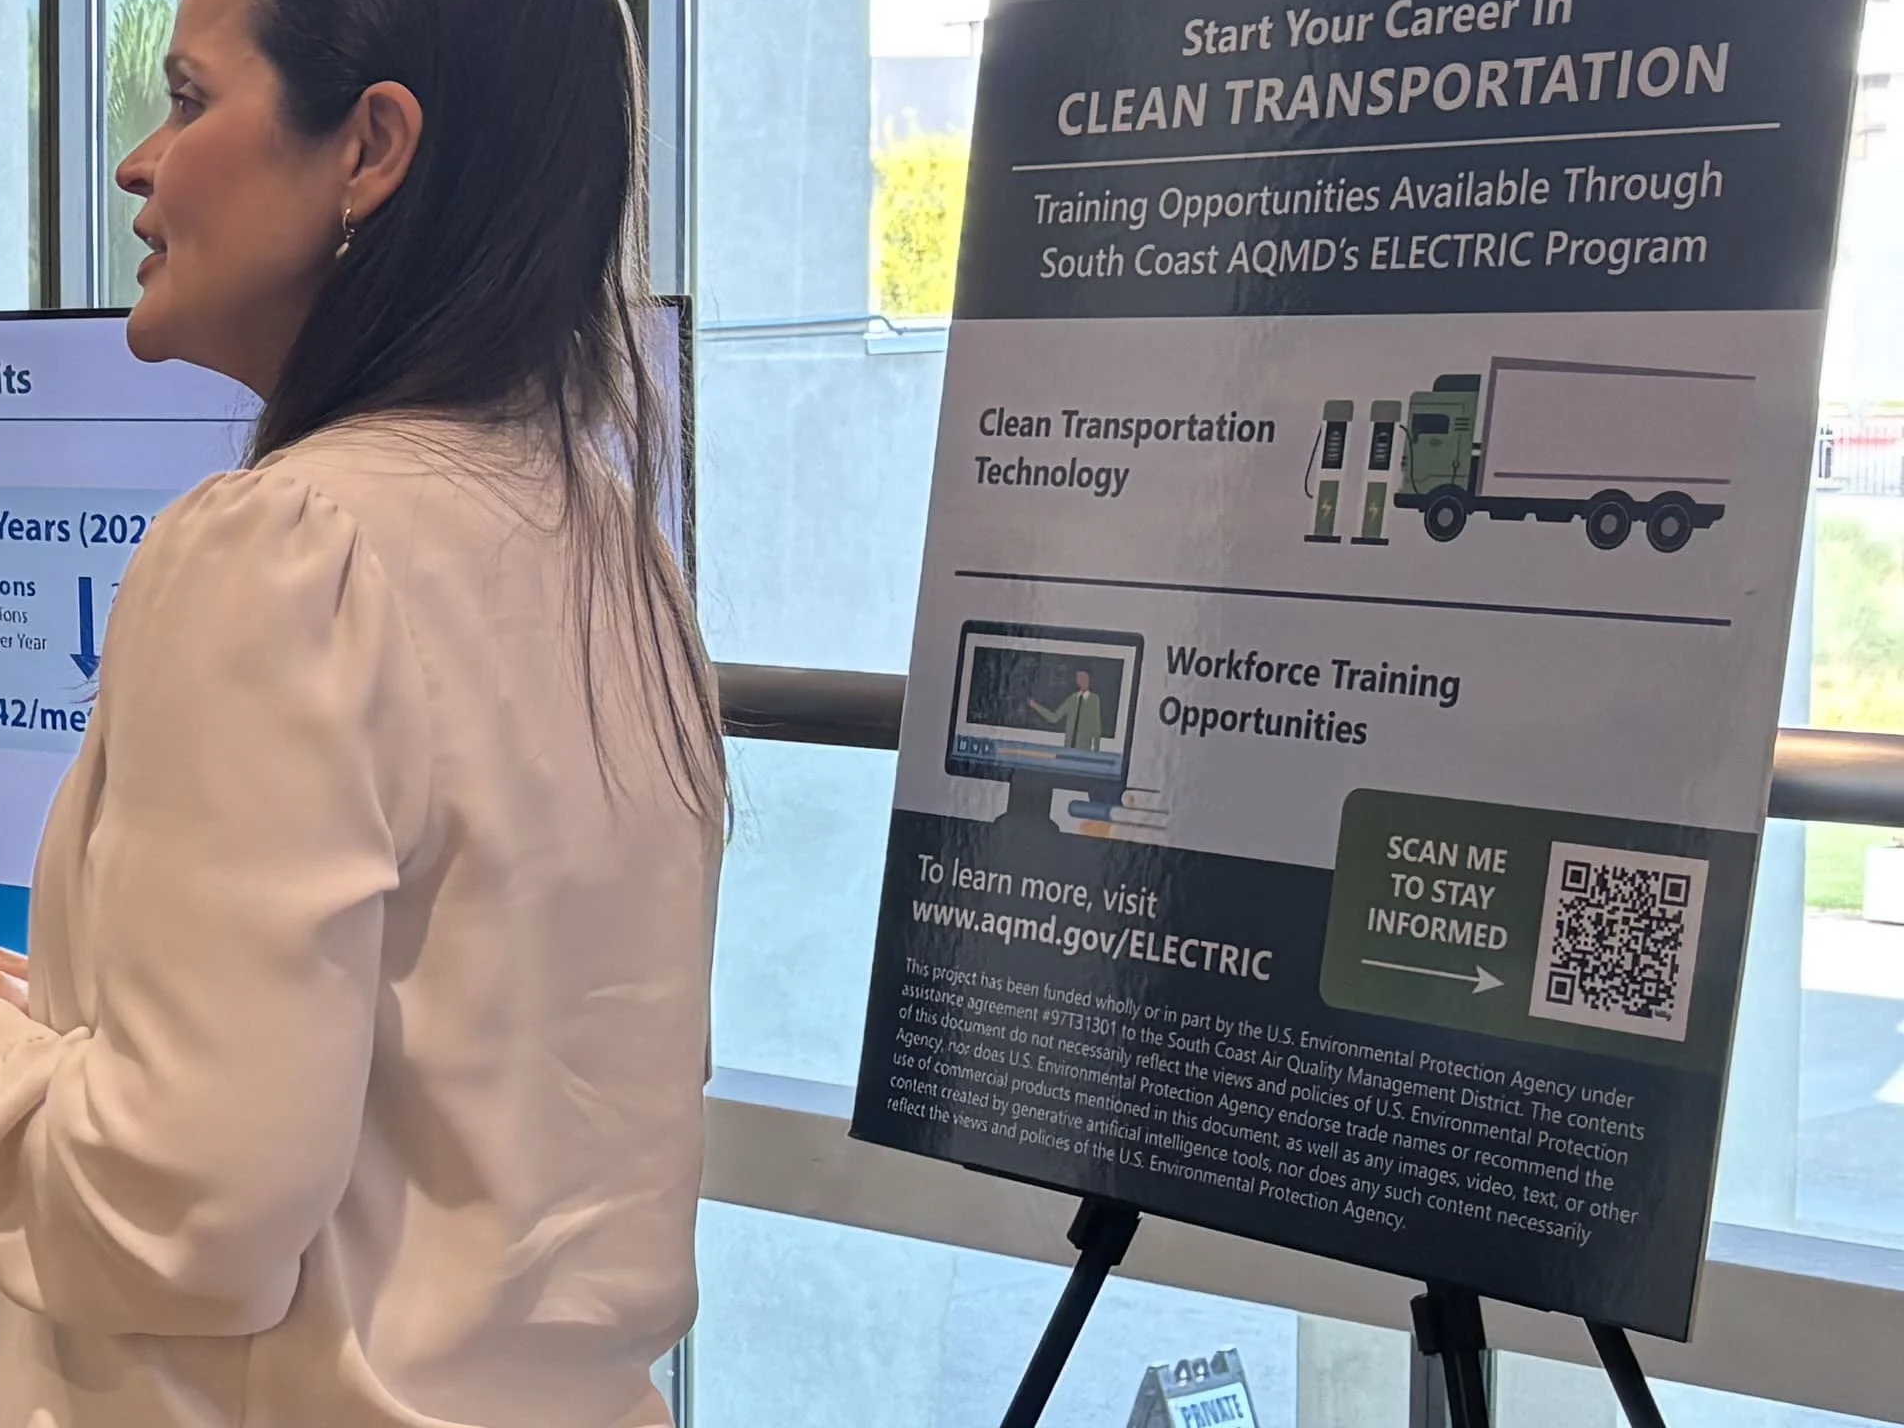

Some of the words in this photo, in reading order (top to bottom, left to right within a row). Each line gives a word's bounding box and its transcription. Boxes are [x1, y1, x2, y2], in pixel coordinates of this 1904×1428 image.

[1182, 16, 1273, 56] Start
[1286, 8, 1374, 47] Your
[1057, 83, 1208, 136] CLEAN
[1225, 42, 1730, 124] TRANSPORTATION
[1034, 191, 1148, 230] Training
[1158, 178, 1380, 228] Opportunities
[1389, 168, 1550, 211] Available
[1564, 160, 1724, 210] Through
[1040, 244, 1124, 278] South
[1134, 243, 1219, 277] Coast
[1227, 238, 1359, 277] AQMD's
[1370, 231, 1534, 270] ELECTRIC
[1545, 230, 1708, 275] Program
[979, 407, 1051, 437] Clean
[1062, 410, 1276, 448] Transportation
[975, 456, 1130, 497] Technology
[80, 512, 159, 548] (202
[17, 634, 47, 651] Year
[1166, 645, 1320, 688] Workforce
[1331, 659, 1460, 708] Training
[1159, 696, 1368, 745] Opportunities
[1387, 835, 1459, 867] SCAN
[1467, 845, 1508, 874] ME
[918, 854, 943, 884] To
[952, 858, 1012, 895] learn
[1021, 877, 1093, 912] more,
[1104, 883, 1158, 919] visit
[1391, 873, 1424, 900] TO
[1431, 878, 1495, 910] STAY
[912, 900, 1273, 981] www.aqmd.gov/ELECTRIC
[1367, 907, 1509, 951] INFORMED
[906, 957, 929, 977] This
[932, 965, 977, 987] project
[981, 972, 1002, 992] has
[1007, 978, 1039, 998] been
[1044, 983, 1092, 1008] funded
[1096, 995, 1140, 1020] wholly
[1144, 1005, 1160, 1019] or
[1164, 1005, 1177, 1022] in
[1181, 1014, 1211, 1031] part
[1216, 1016, 1234, 1038] by
[1238, 1021, 1263, 1039] the
[1267, 1024, 1295, 1046] U.S.
[1301, 1031, 1414, 1068] Environmental
[1420, 1052, 1505, 1085] Protection
[1510, 1070, 1576, 1102] Agency
[1581, 1084, 1635, 1109] under
[899, 1004, 913, 1020] of
[916, 1008, 937, 1026] this
[941, 1013, 1006, 1040] document
[1010, 1025, 1028, 1044] do
[1032, 1031, 1054, 1050] not
[1058, 1038, 1133, 1068] necessarily
[1136, 1052, 1180, 1075] reflect
[1185, 1061, 1208, 1080] the
[1213, 1066, 1253, 1089] views
[1257, 1077, 1286, 1096] and
[1291, 1083, 1350, 1111] policies
[1354, 1095, 1371, 1113] of
[1376, 1100, 1405, 1120] U.S.
[1411, 1105, 1532, 1146] Environmental
[1537, 1131, 1629, 1166] Protection
[902, 984, 964, 1008] assistance
[967, 996, 1038, 1021] agreement
[1043, 1007, 1116, 1037] #97T31301
[1122, 1024, 1136, 1040] to
[1141, 1027, 1164, 1047] the
[1167, 1031, 1210, 1054] South
[1215, 1041, 1256, 1065] Coast
[1261, 1050, 1284, 1069] Air
[1287, 1055, 1343, 1084] Quality
[1347, 1066, 1456, 1103] Management
[1461, 1088, 1524, 1117] District.
[1531, 1101, 1562, 1124] The
[1567, 1113, 1645, 1141] contents
